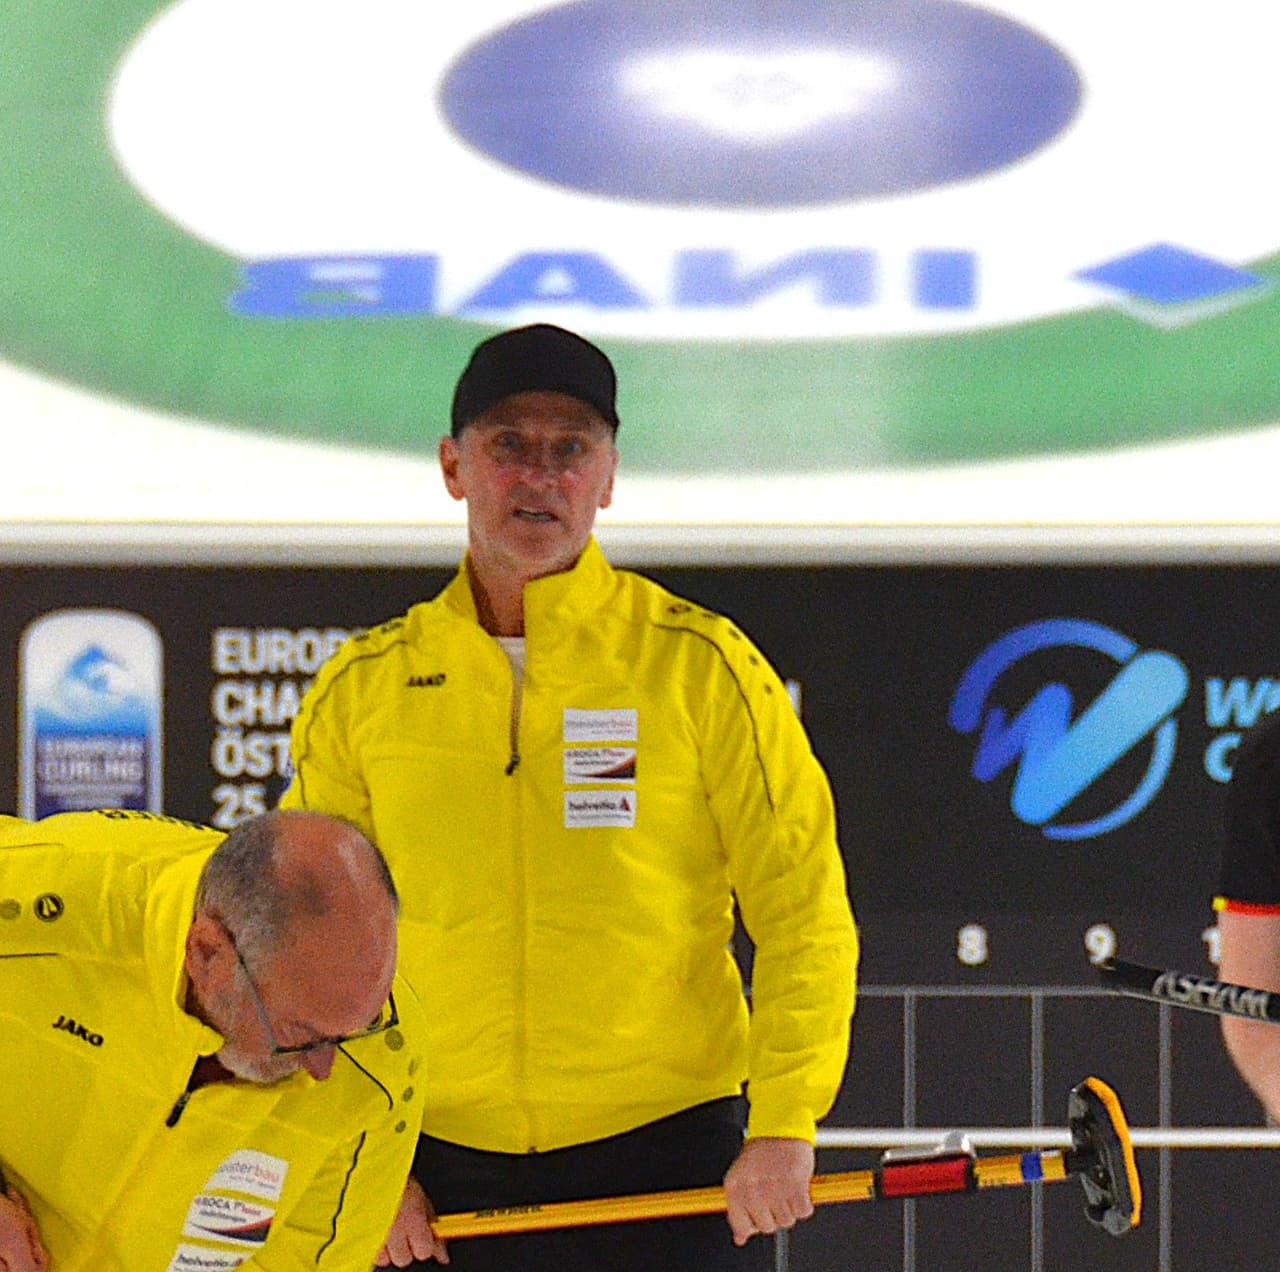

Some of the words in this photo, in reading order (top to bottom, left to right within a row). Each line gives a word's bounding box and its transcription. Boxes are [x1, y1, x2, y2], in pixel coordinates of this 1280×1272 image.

[213, 627, 368, 673] EUROP
[213, 679, 312, 726] CHA
[957, 922, 989, 967] 8
[1084, 922, 1117, 967] 9
[52, 1014, 104, 1046] JAKO
